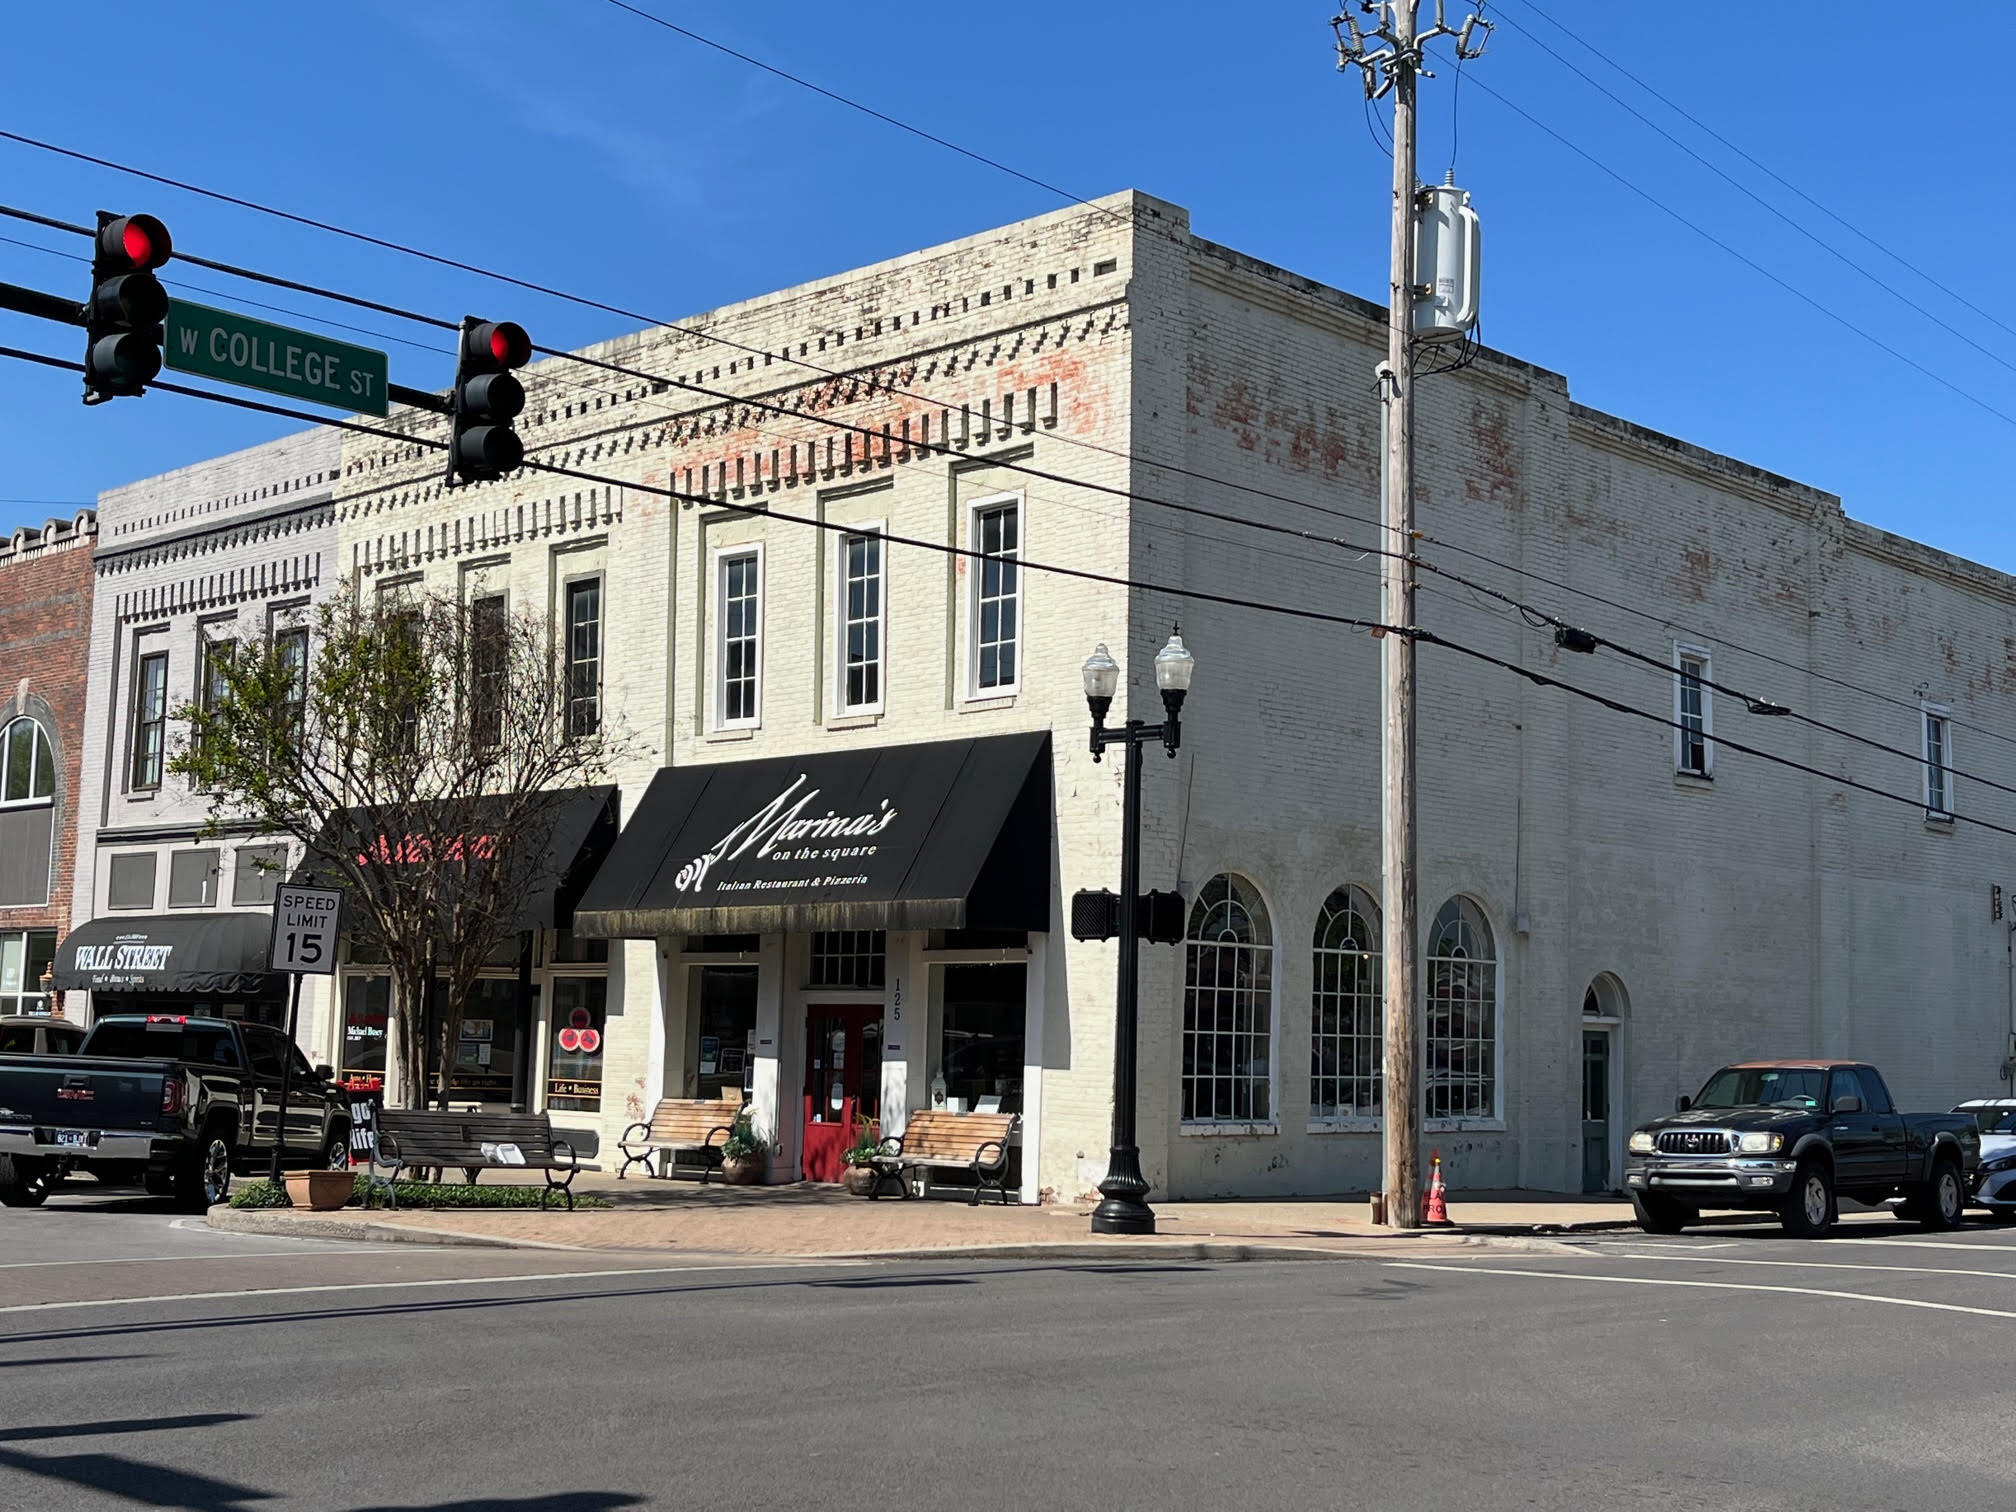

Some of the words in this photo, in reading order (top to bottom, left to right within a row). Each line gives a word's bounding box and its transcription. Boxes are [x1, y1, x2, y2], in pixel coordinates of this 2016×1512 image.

[180, 326, 198, 355] W
[209, 327, 340, 390] COLLEGE
[350, 370, 374, 397] ST
[711, 774, 898, 860] Marina's
[772, 848, 790, 861] on
[796, 847, 819, 858] the
[824, 844, 877, 861] square
[717, 880, 751, 891] Italian
[753, 876, 809, 890] Restaurant
[812, 876, 821, 886] &
[823, 873, 868, 886] Pizzeria
[283, 895, 336, 911] SPEED
[287, 913, 328, 929] LIMIT
[286, 932, 322, 964] 15
[74, 945, 114, 971] WALL
[114, 944, 173, 970] STREET
[554, 1082, 567, 1093] Life
[573, 1083, 599, 1095] Business
